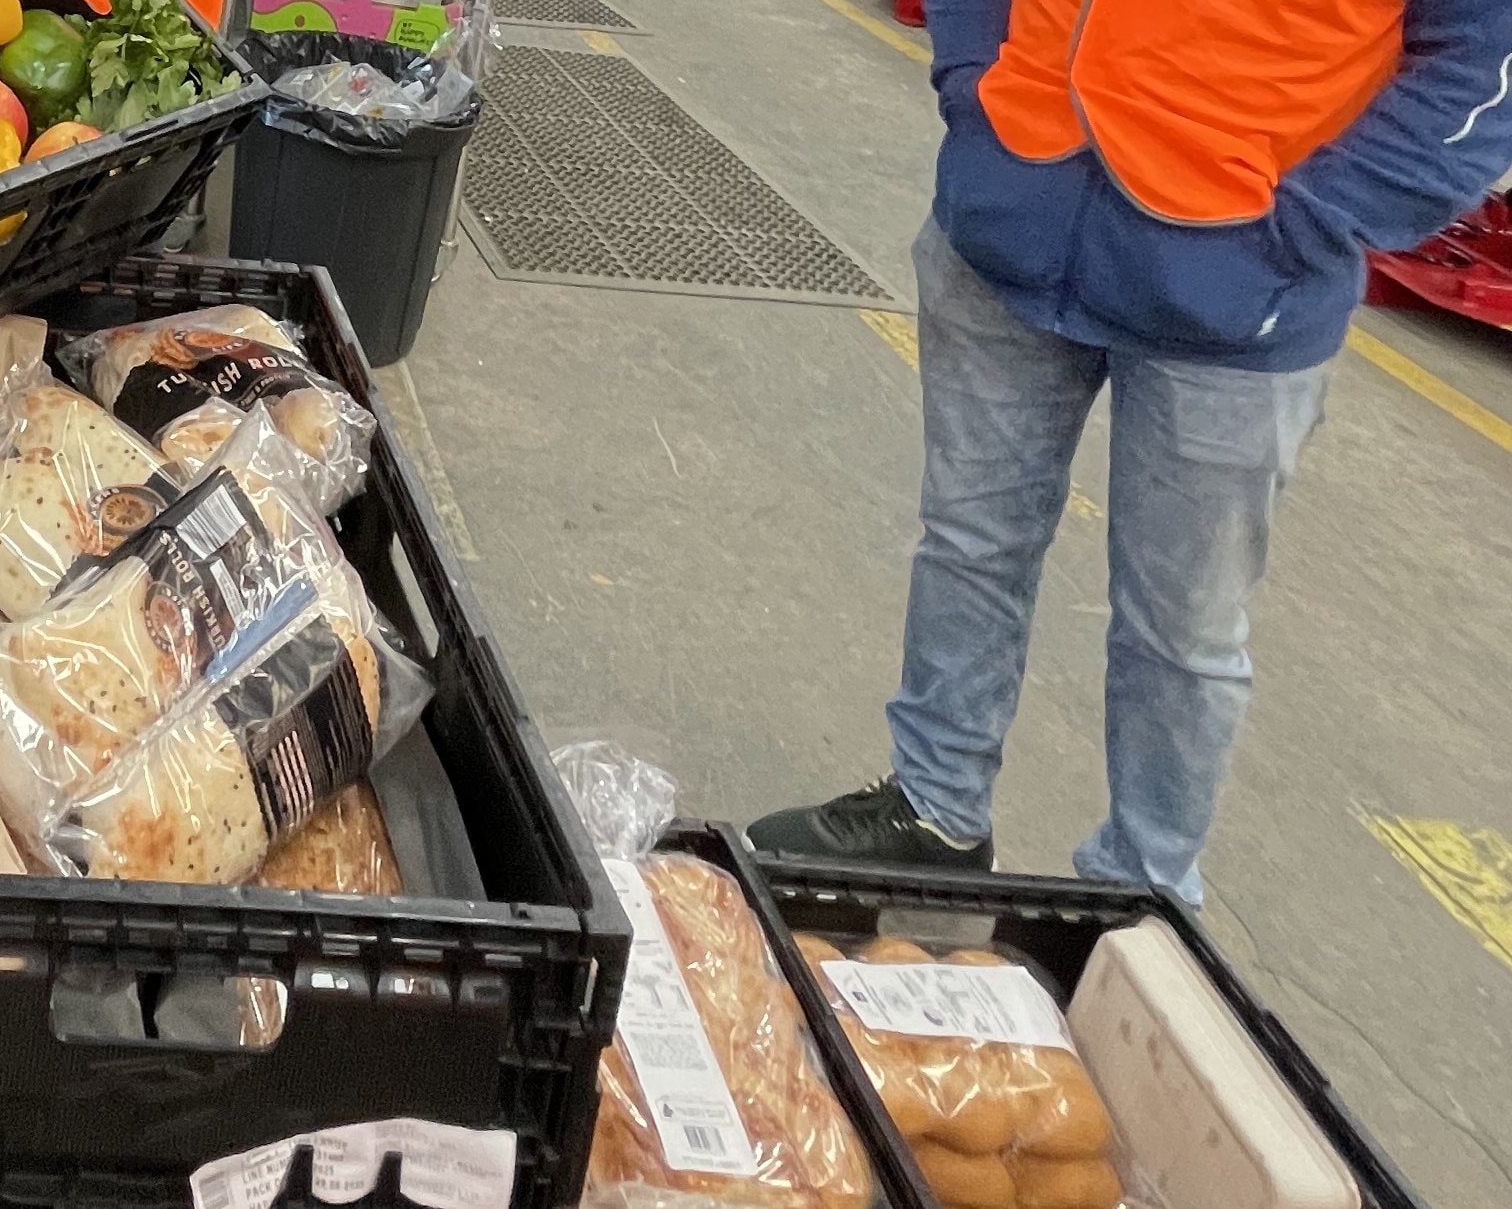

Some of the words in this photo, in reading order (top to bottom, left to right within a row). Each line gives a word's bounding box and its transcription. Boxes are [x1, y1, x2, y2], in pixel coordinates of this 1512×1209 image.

[157, 362, 242, 394] TUISH
[159, 530, 195, 583] ROLLS
[192, 585, 227, 650] URKISH
